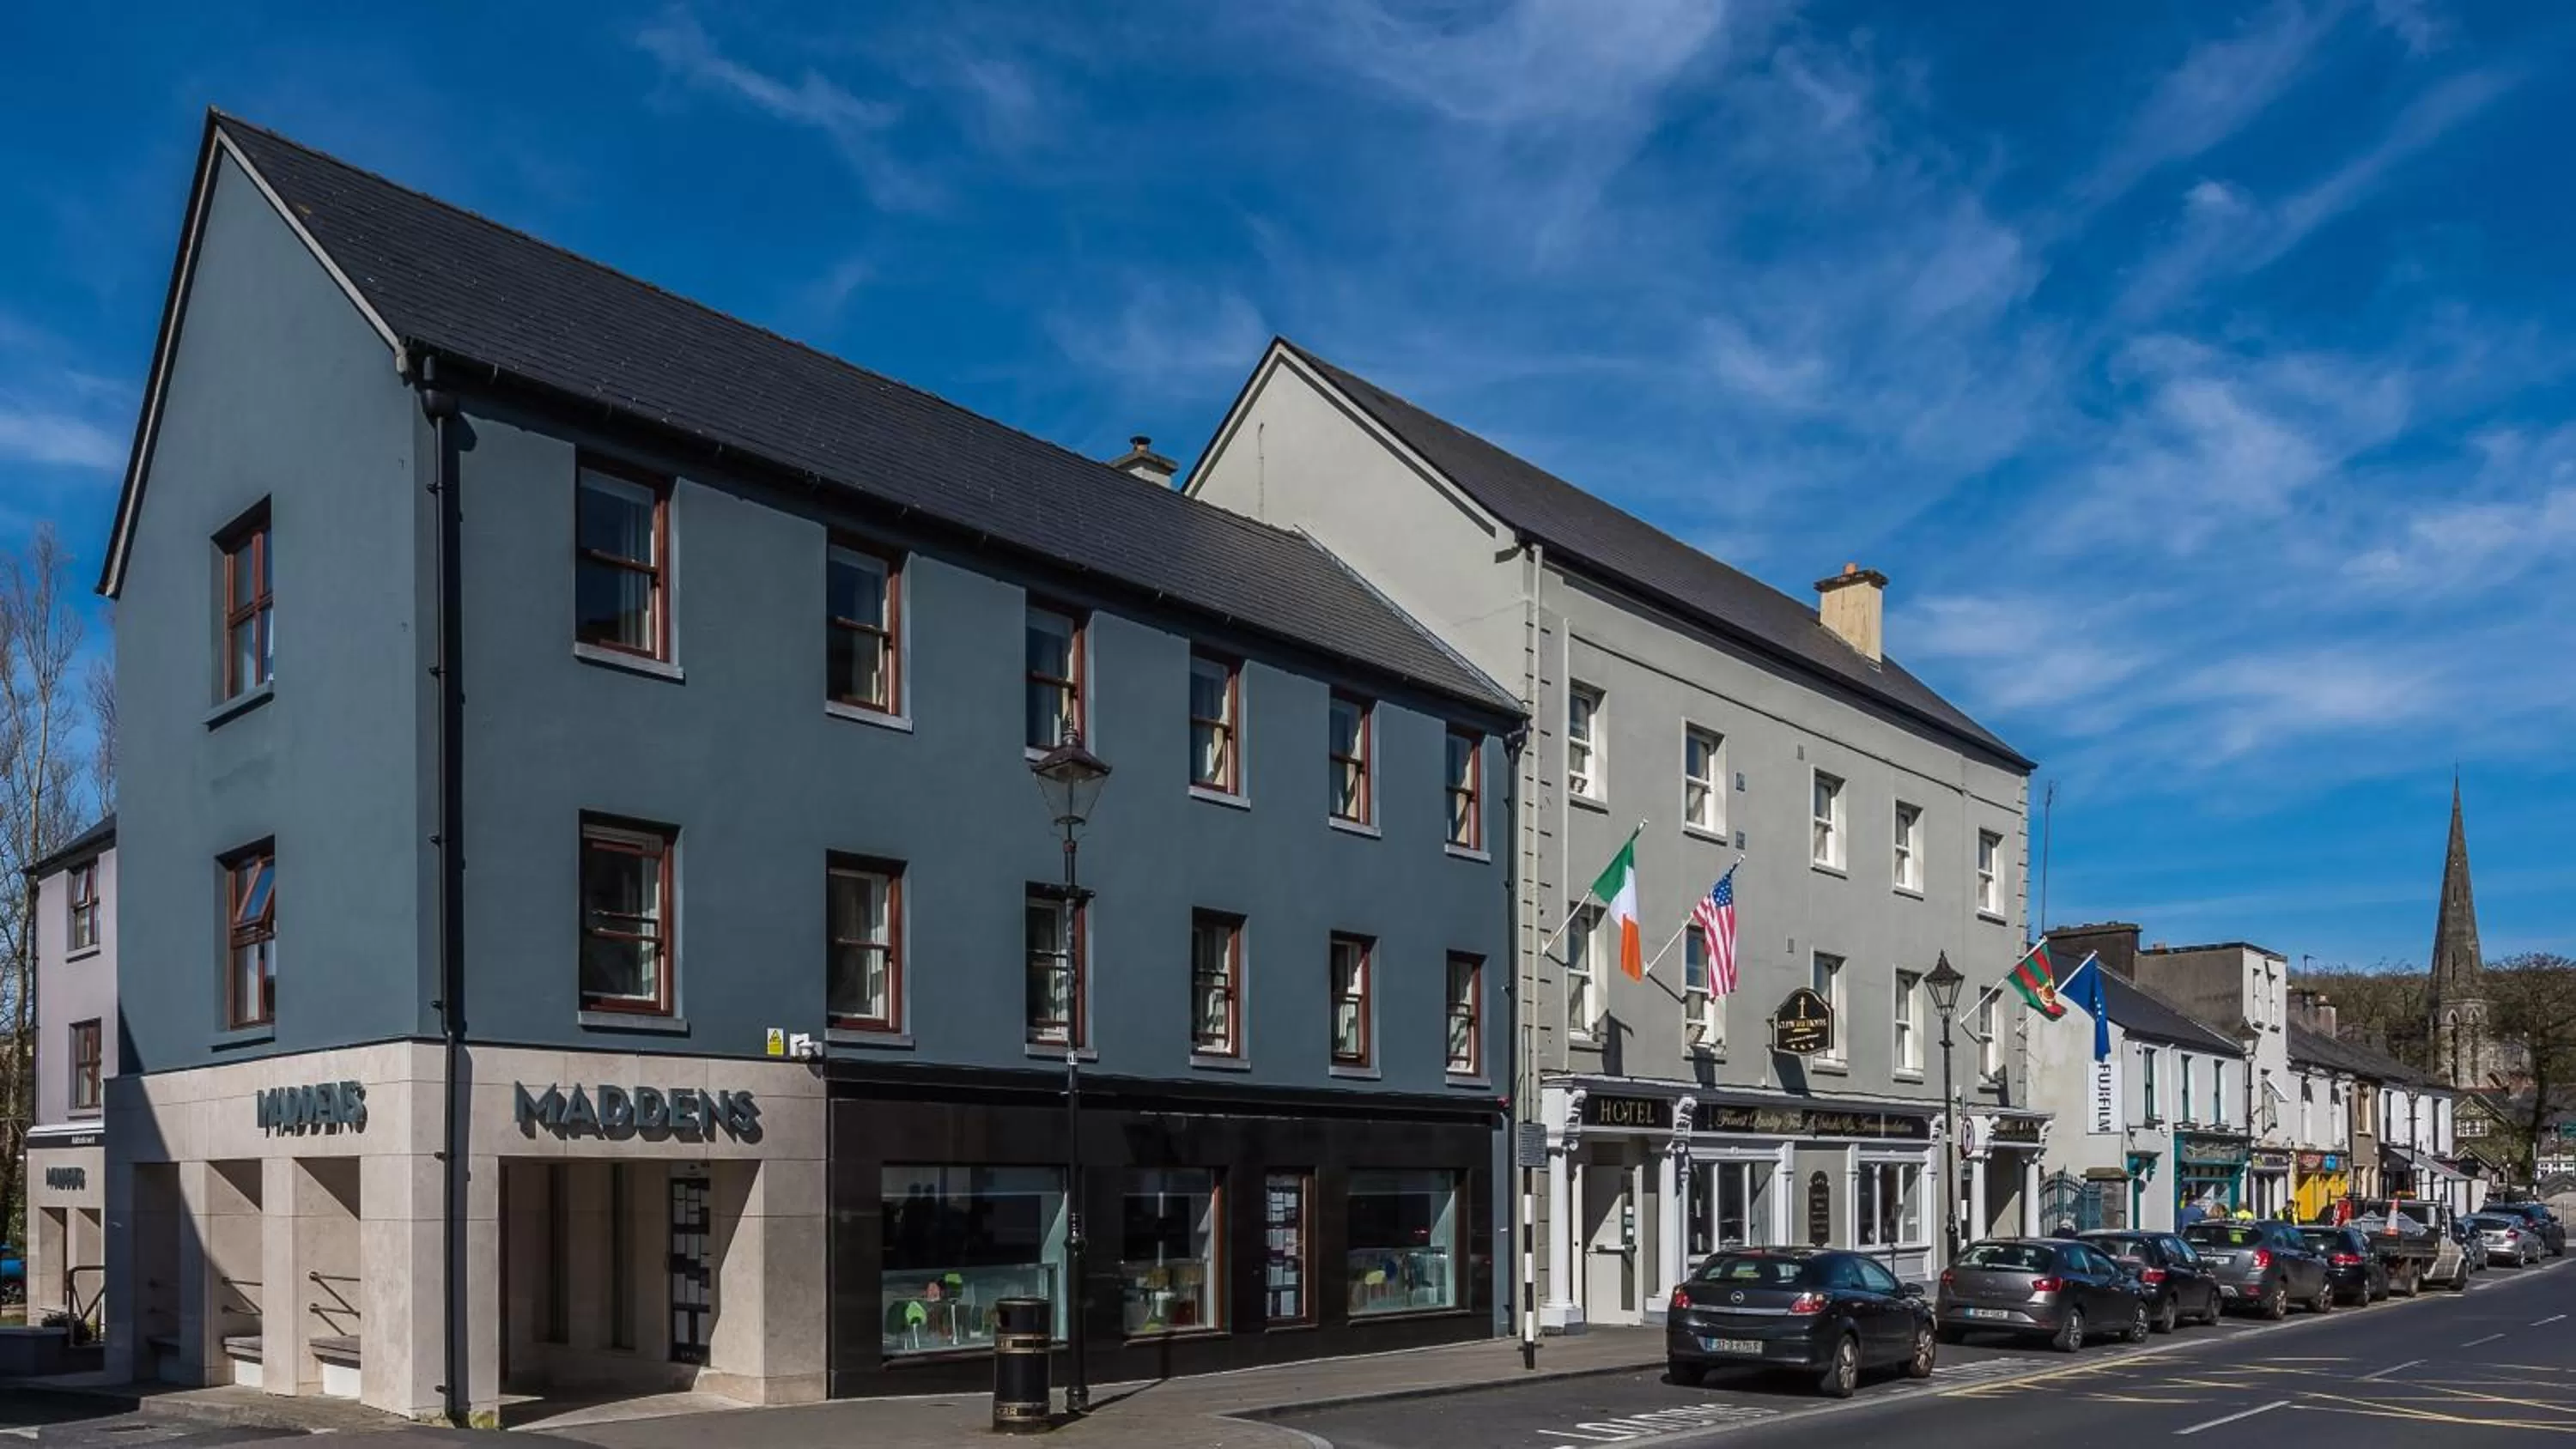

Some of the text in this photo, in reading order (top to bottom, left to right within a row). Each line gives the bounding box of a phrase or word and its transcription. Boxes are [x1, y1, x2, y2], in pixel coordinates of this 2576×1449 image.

[514, 1079, 759, 1133] MADDENS
[1601, 1098, 1655, 1125] HOTEL
[2098, 1064, 2111, 1131] FUJIFILM
